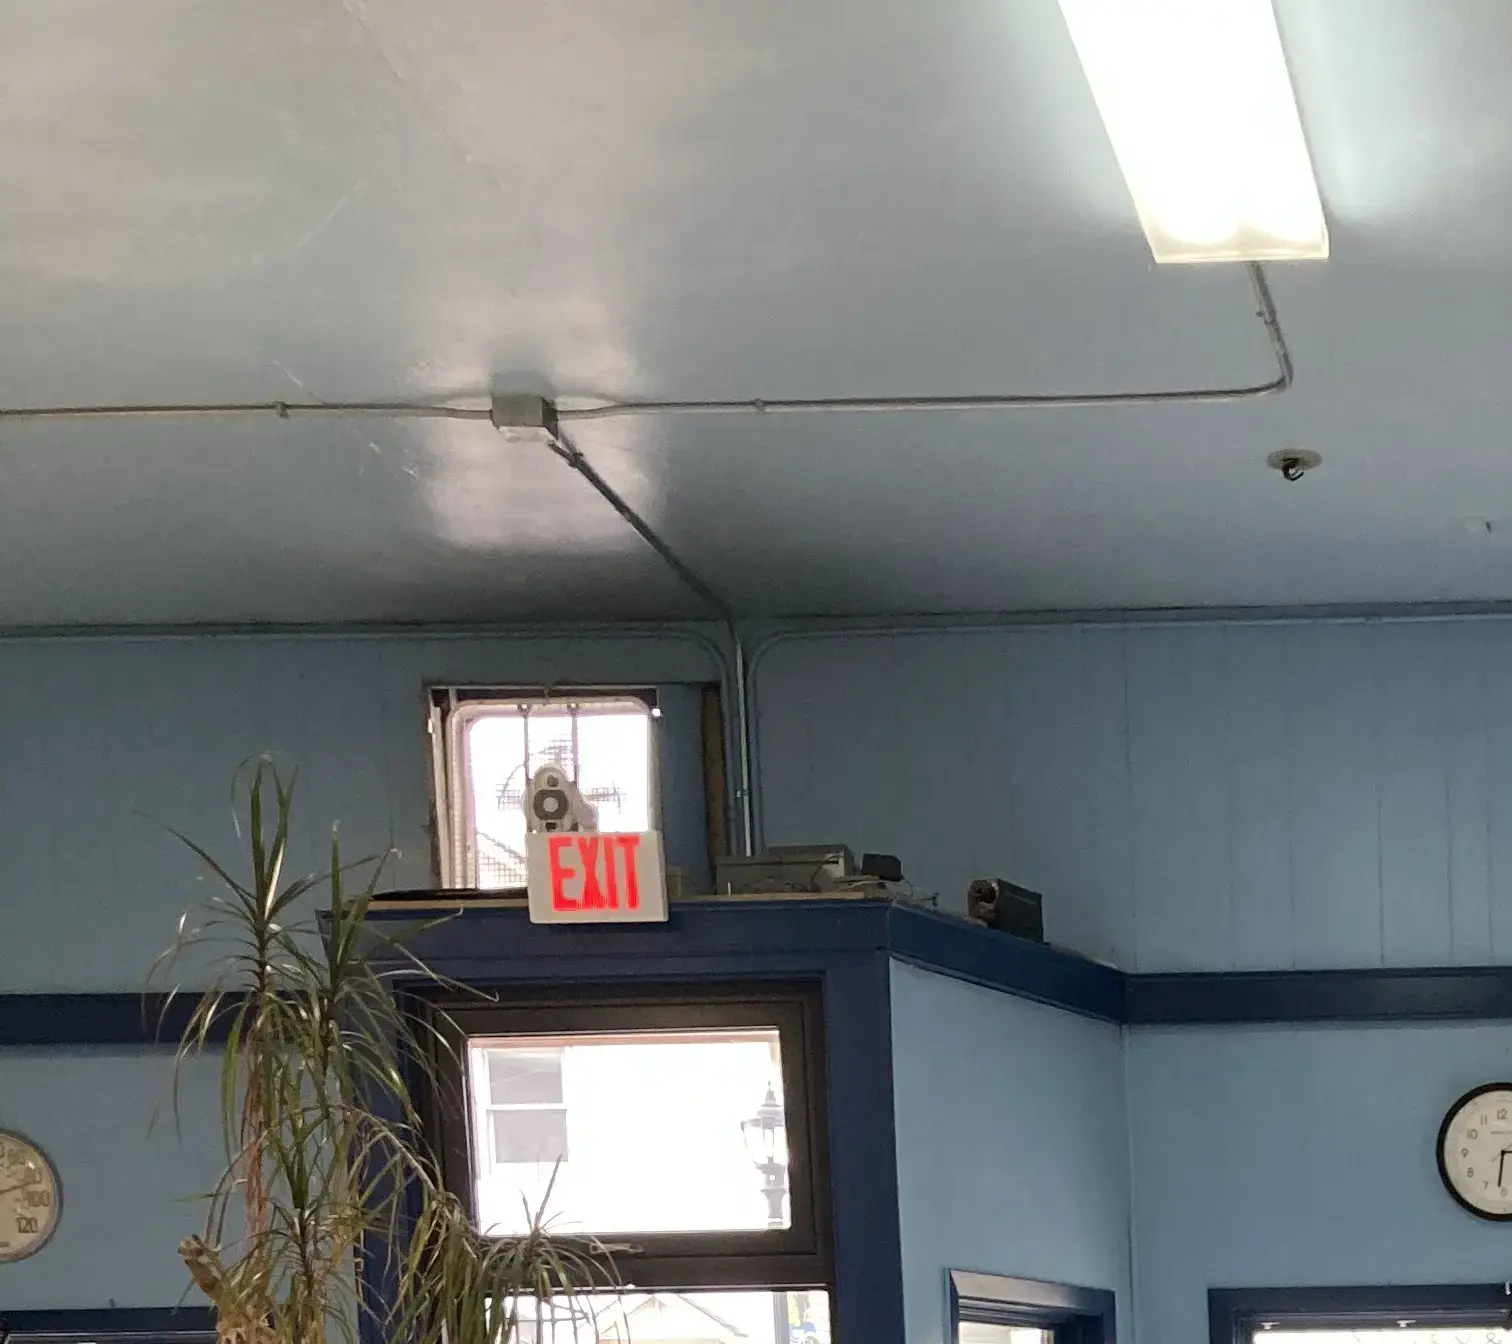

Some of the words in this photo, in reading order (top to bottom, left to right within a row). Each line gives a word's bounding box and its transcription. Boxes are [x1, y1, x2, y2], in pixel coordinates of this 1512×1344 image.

[548, 834, 641, 912] EXIT
[1496, 1108, 1508, 1120] 12
[1480, 1115, 1488, 1126] 11
[1466, 1128, 1478, 1140] 10
[1461, 1148, 1469, 1159] 9
[1466, 1167, 1474, 1178] 8
[1482, 1181, 1490, 1190] 7
[1500, 1186, 1508, 1197] 6
